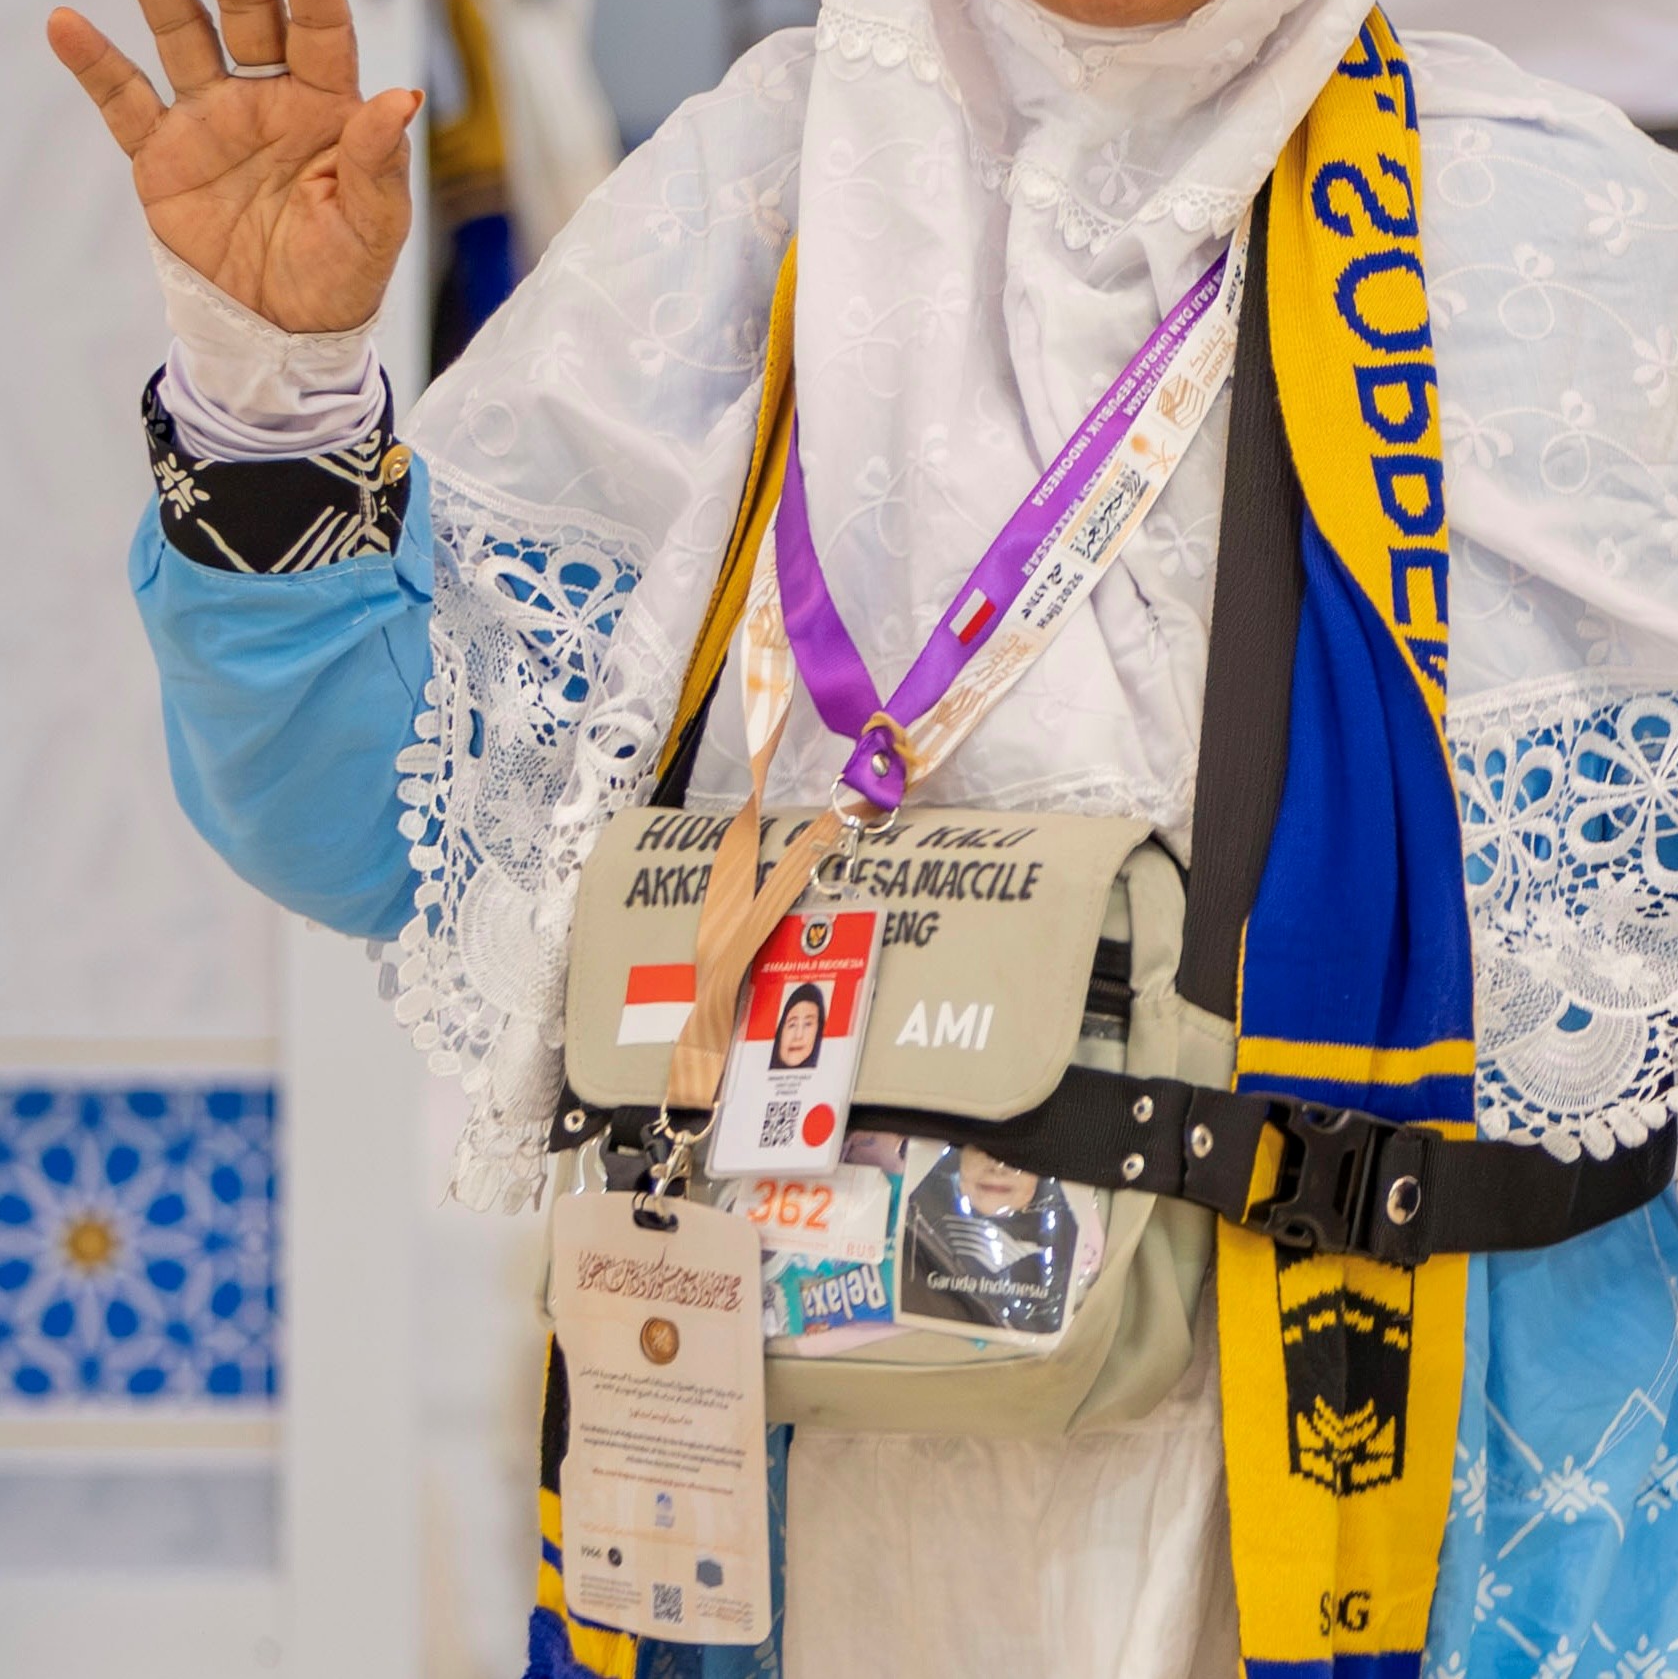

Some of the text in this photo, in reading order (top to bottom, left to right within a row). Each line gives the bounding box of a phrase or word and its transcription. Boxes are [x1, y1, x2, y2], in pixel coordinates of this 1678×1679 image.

[1190, 280, 1218, 311] HAJI
[1167, 306, 1195, 337] DAN
[1132, 332, 1173, 381] UMRAH
[1086, 375, 1138, 437] REPUBLIK
[1030, 434, 1092, 509] INDONESIA
[1035, 570, 1085, 632] Hajj 2026
[818, 955, 864, 971] INDONESIA
[895, 1000, 995, 1051] AMI
[748, 1178, 834, 1229] 362
[802, 1265, 888, 1320] Relaxa
[926, 1270, 1051, 1302] Garuda Indonesia
